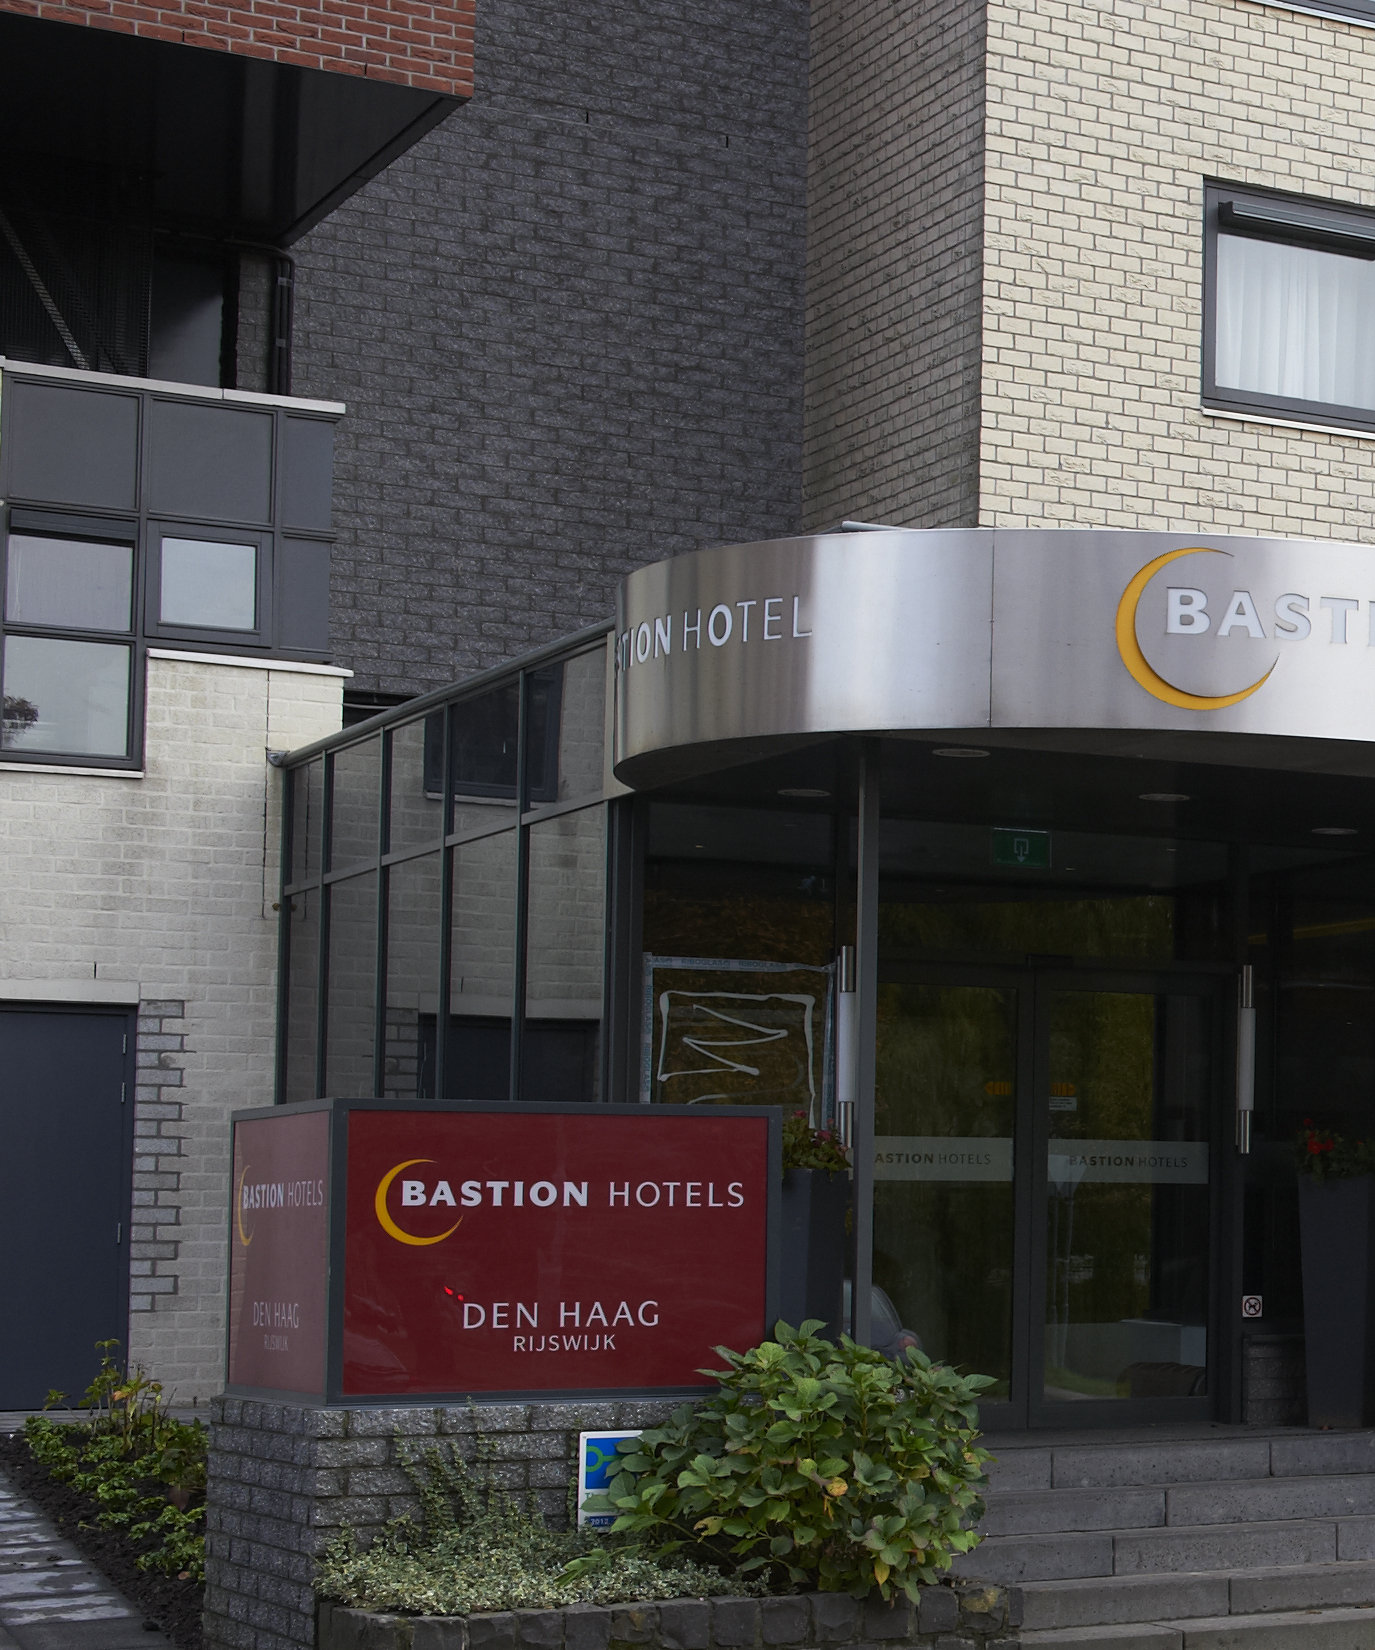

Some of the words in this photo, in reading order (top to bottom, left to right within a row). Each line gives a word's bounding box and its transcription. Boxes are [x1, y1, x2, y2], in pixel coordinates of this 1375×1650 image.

[682, 595, 813, 652] HOTEL
[875, 1152, 934, 1164] ASTION
[938, 1153, 992, 1165] HOTELS
[1069, 1155, 1134, 1167] BASTION
[1138, 1156, 1188, 1168] HOTELS
[243, 1182, 284, 1210] BASTION
[287, 1179, 323, 1207] HOTELS
[402, 1180, 588, 1207] BASTION
[609, 1181, 745, 1208] HOTELS
[253, 1301, 271, 1327] DEN
[274, 1301, 300, 1328] HAAG
[463, 1302, 538, 1329] DEN
[559, 1300, 660, 1328] HAAG
[513, 1334, 617, 1352] RIJSWIJK
